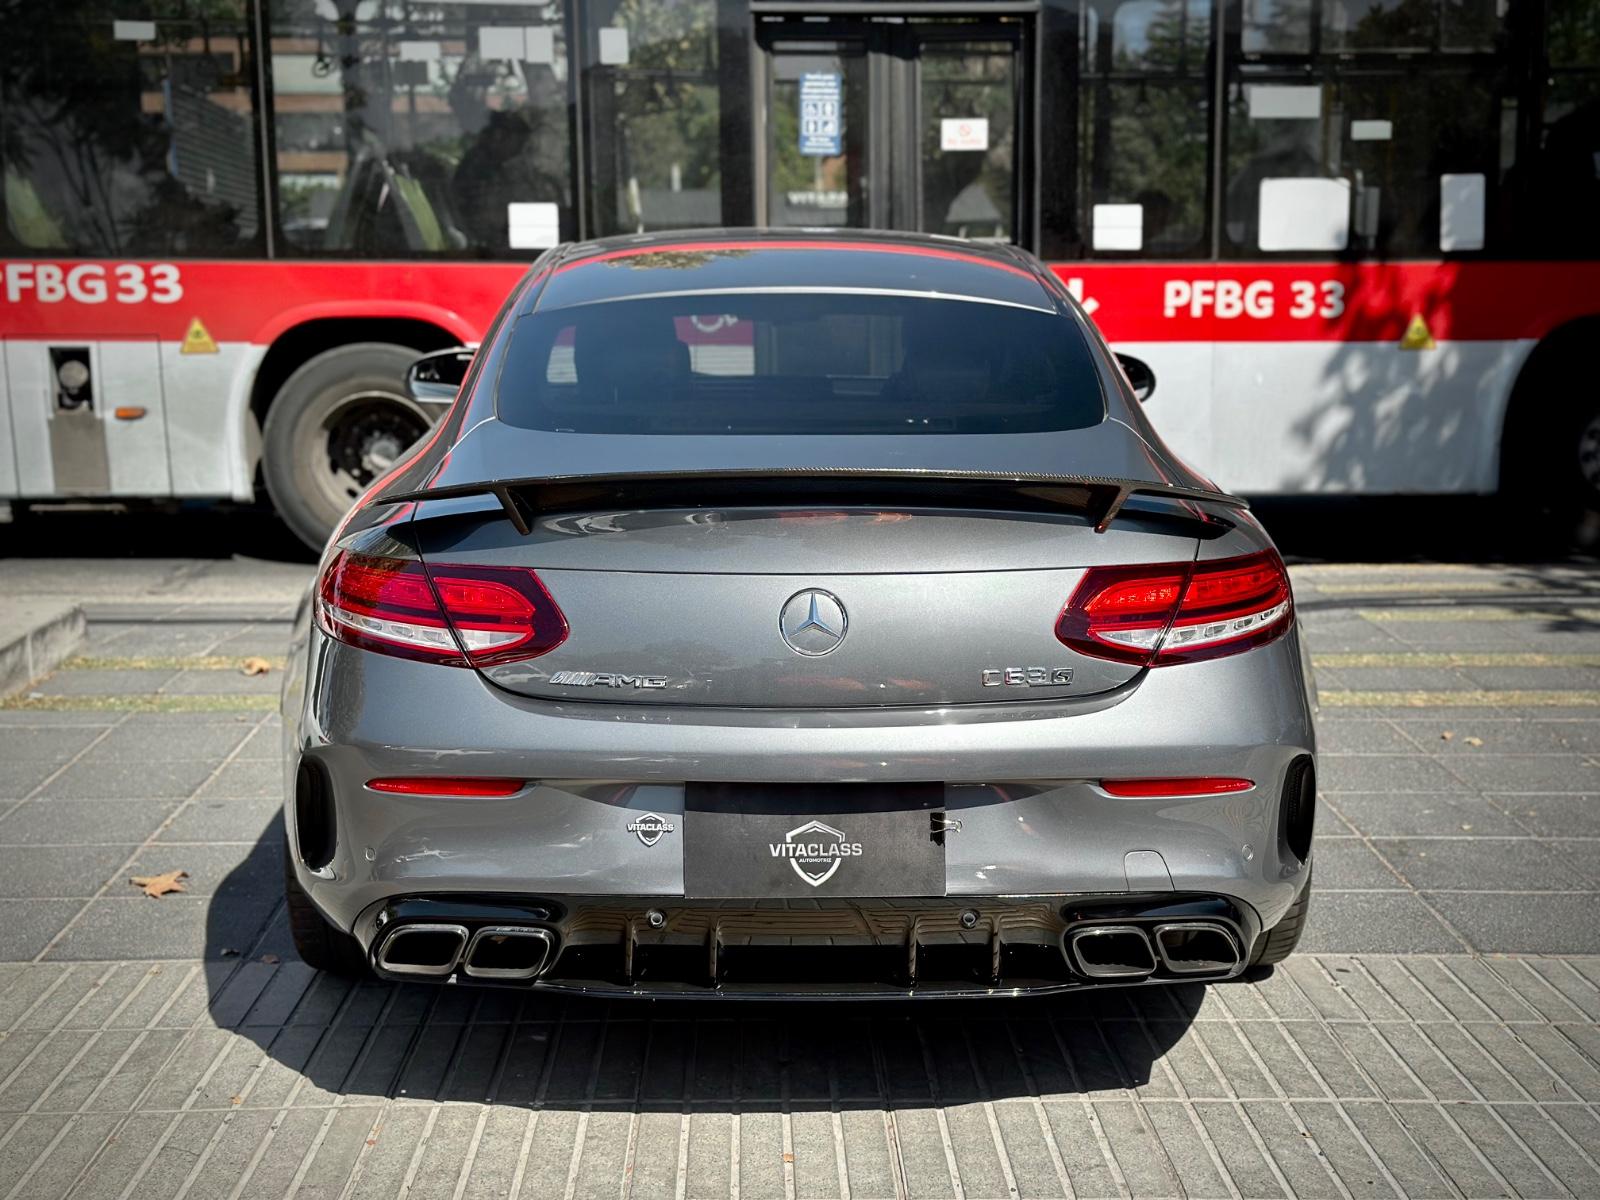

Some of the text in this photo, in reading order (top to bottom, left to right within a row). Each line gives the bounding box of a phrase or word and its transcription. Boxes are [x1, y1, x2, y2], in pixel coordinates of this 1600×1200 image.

[0, 264, 184, 303] FBG 33
[1163, 280, 1345, 319] PFBG 33
[592, 672, 667, 689] AMG
[627, 823, 674, 832] VITACLASS
[769, 843, 862, 857] VITACLASS
